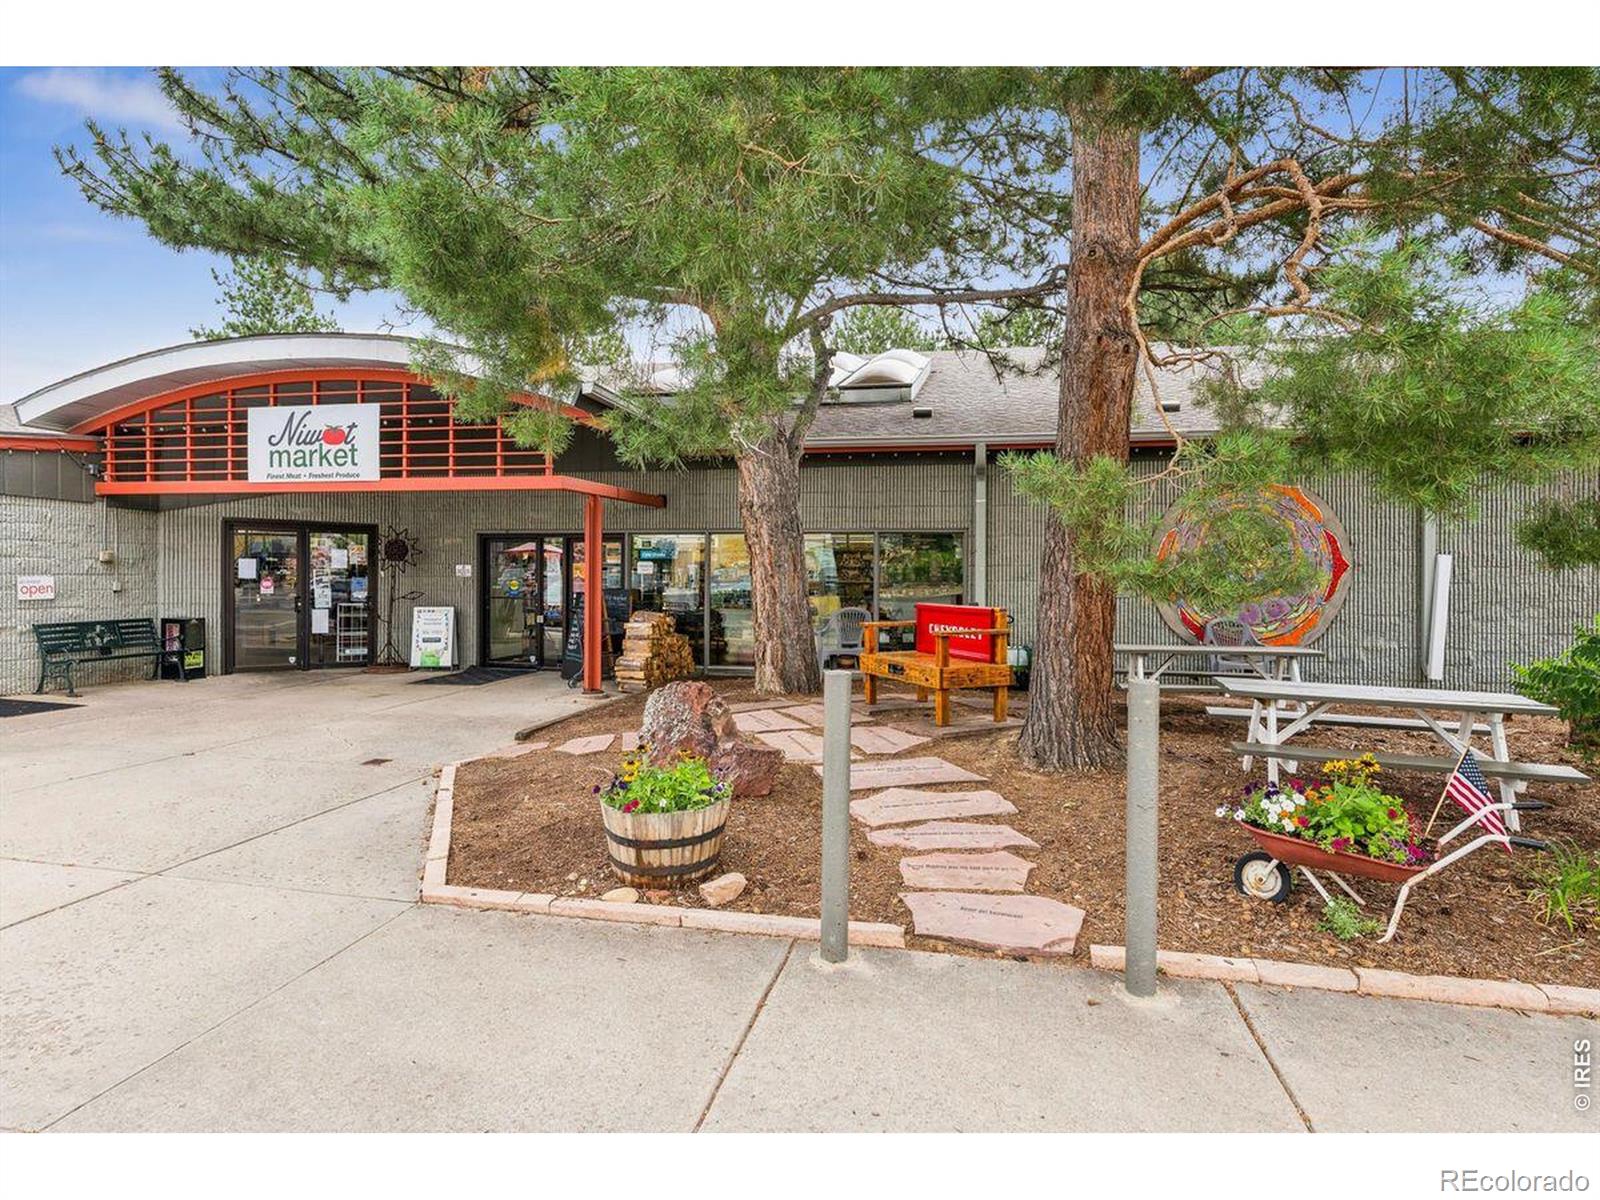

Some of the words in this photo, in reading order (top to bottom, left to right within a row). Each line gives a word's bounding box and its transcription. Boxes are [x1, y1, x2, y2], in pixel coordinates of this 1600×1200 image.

[269, 443, 358, 468] market
[266, 472, 285, 480] Finest
[335, 471, 360, 479] Produce
[20, 584, 54, 598] open
